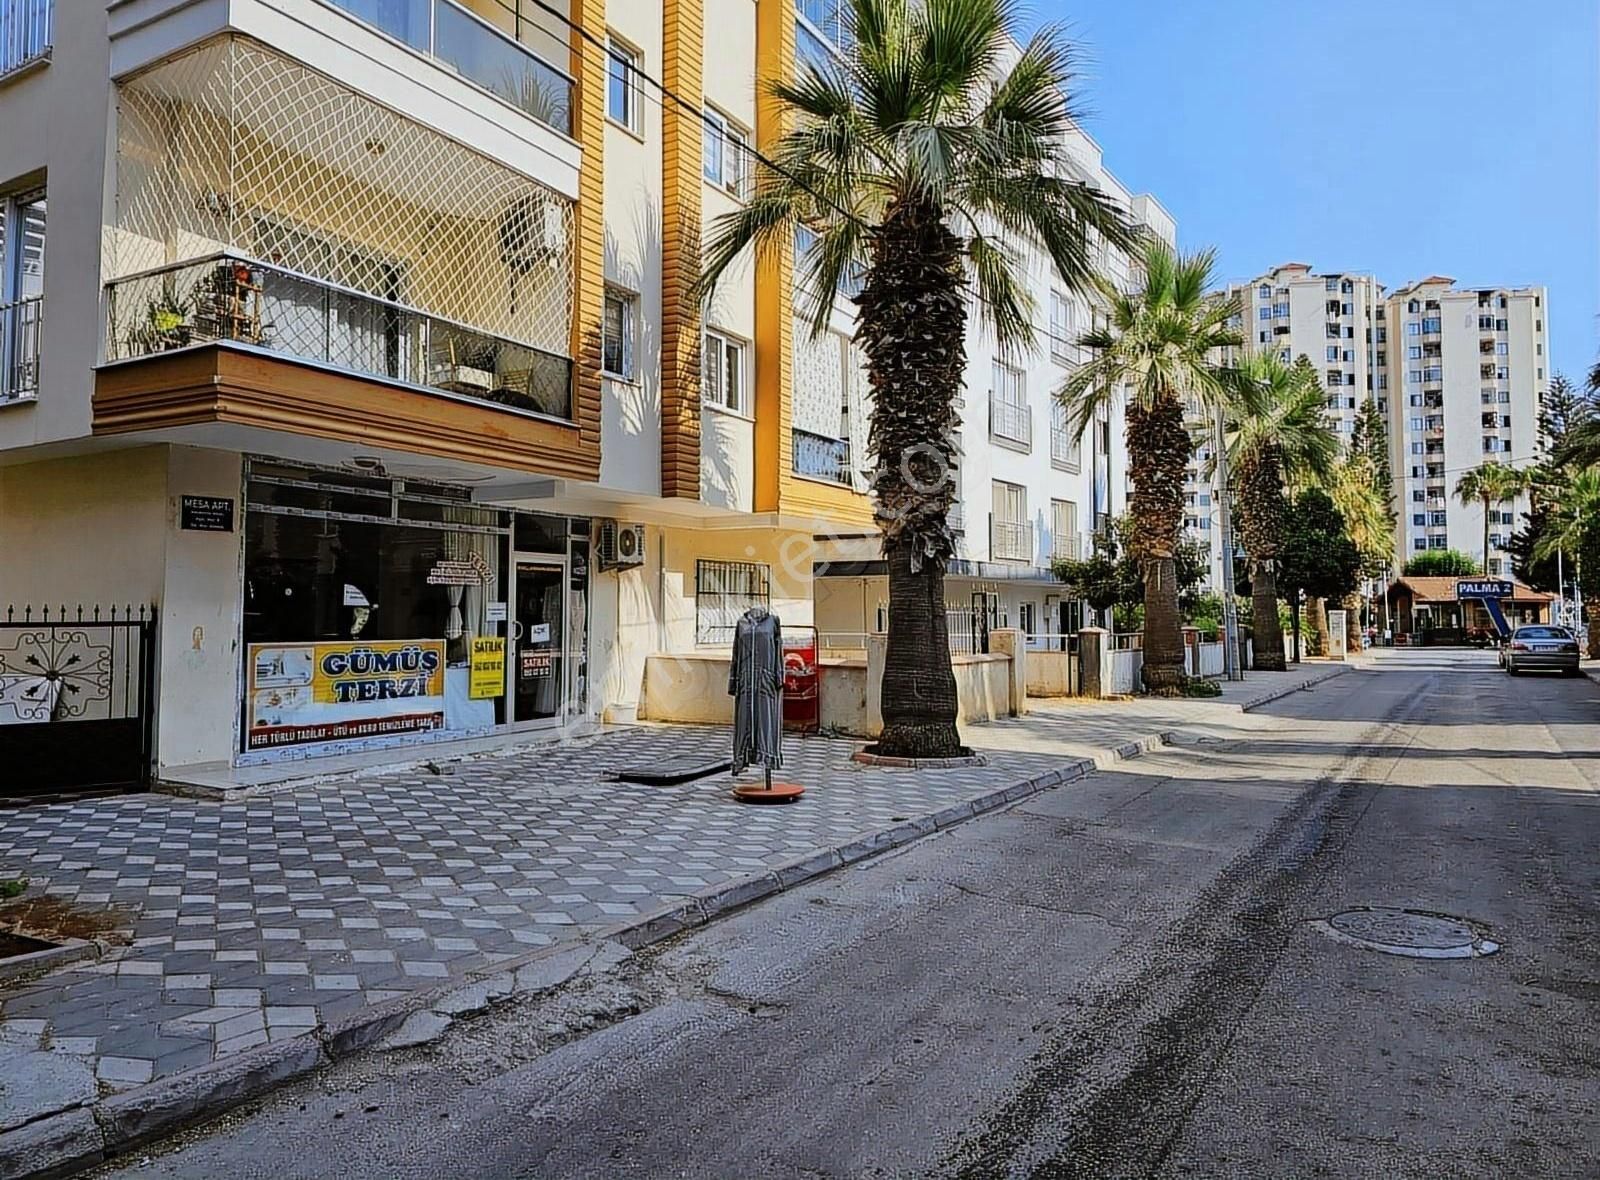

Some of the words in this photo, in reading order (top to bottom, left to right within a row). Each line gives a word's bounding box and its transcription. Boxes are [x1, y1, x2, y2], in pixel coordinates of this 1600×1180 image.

[1459, 583, 1500, 592] PALMA
[1504, 583, 1511, 592] 2
[474, 641, 503, 653] SATILIK
[322, 646, 438, 676] GÜMÜŞ
[333, 673, 429, 703] TERZİ
[252, 734, 268, 746] HER
[270, 729, 296, 744] TÜRLÜ
